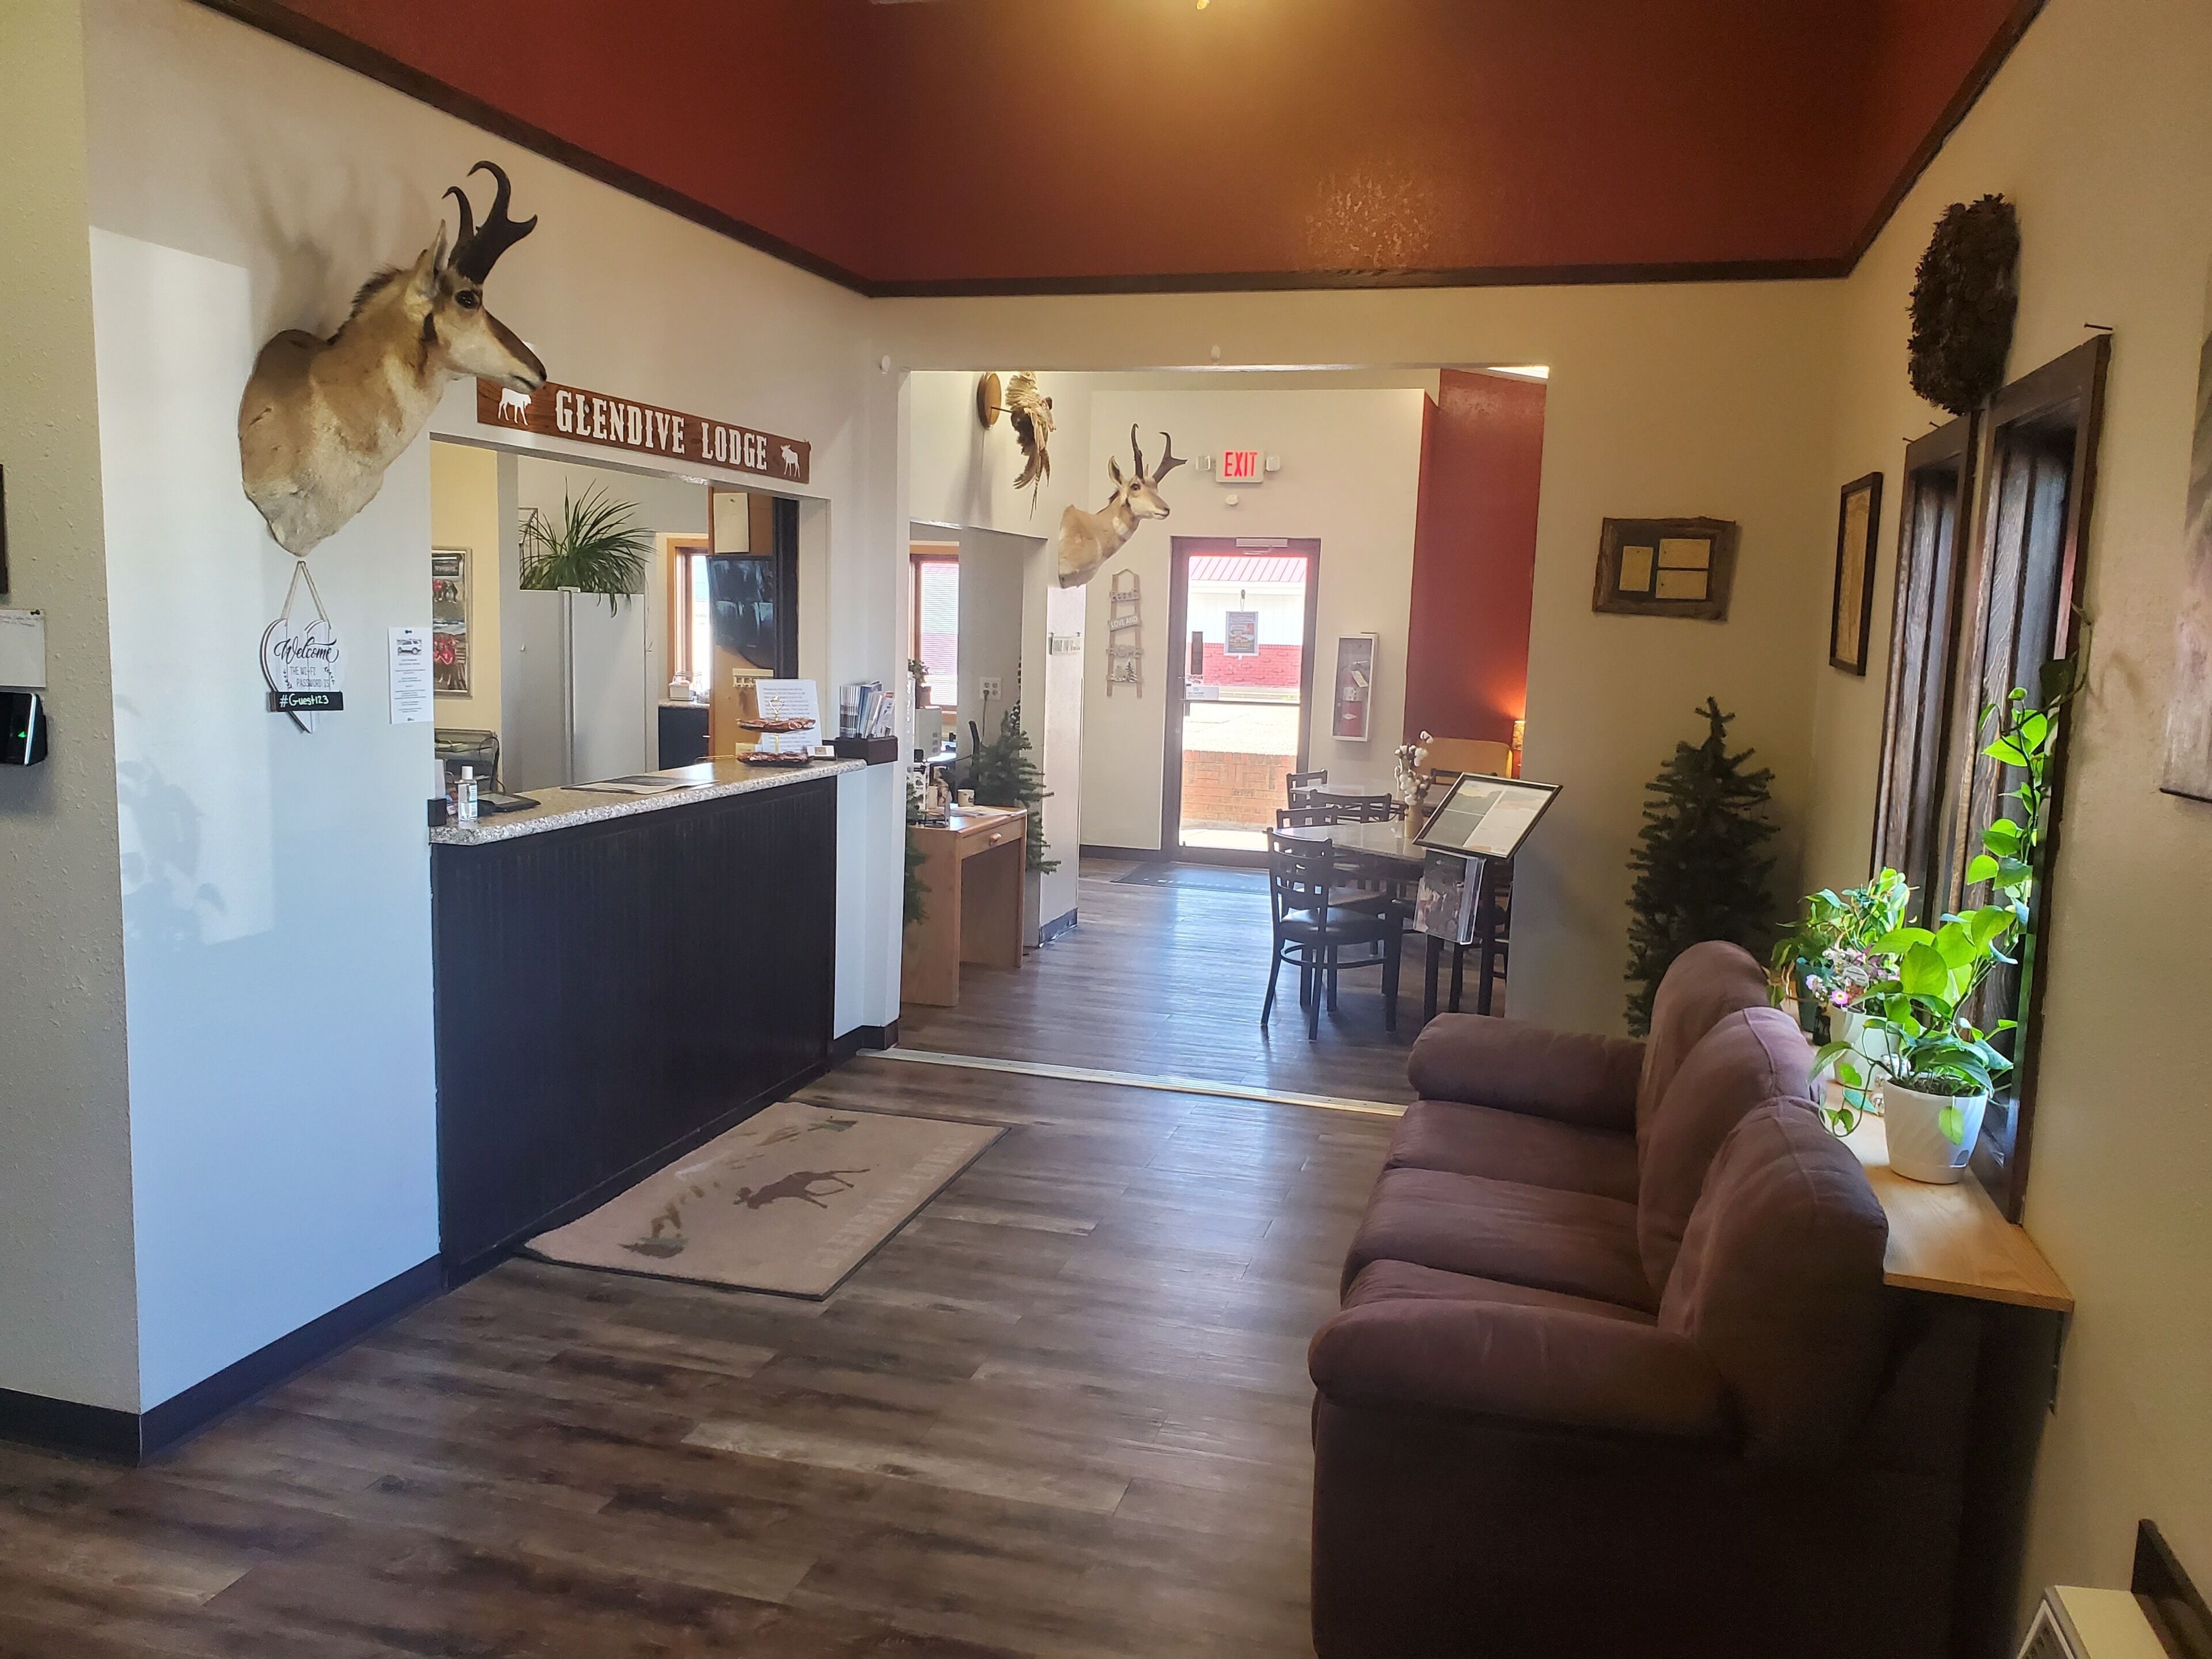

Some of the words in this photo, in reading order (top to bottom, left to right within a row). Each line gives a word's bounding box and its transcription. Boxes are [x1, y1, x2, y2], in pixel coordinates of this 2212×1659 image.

[555, 389, 685, 454] GLENDIVE
[701, 422, 768, 471] LODGE
[1224, 451, 1258, 477] EXIT
[1110, 618, 1125, 628] LOVE
[1125, 615, 1138, 624] AND
[274, 635, 339, 664] Welcome
[290, 666, 299, 676] THE
[296, 678, 321, 688] PASSWORD
[324, 679, 330, 688] IS
[279, 693, 329, 708] #Guest123
